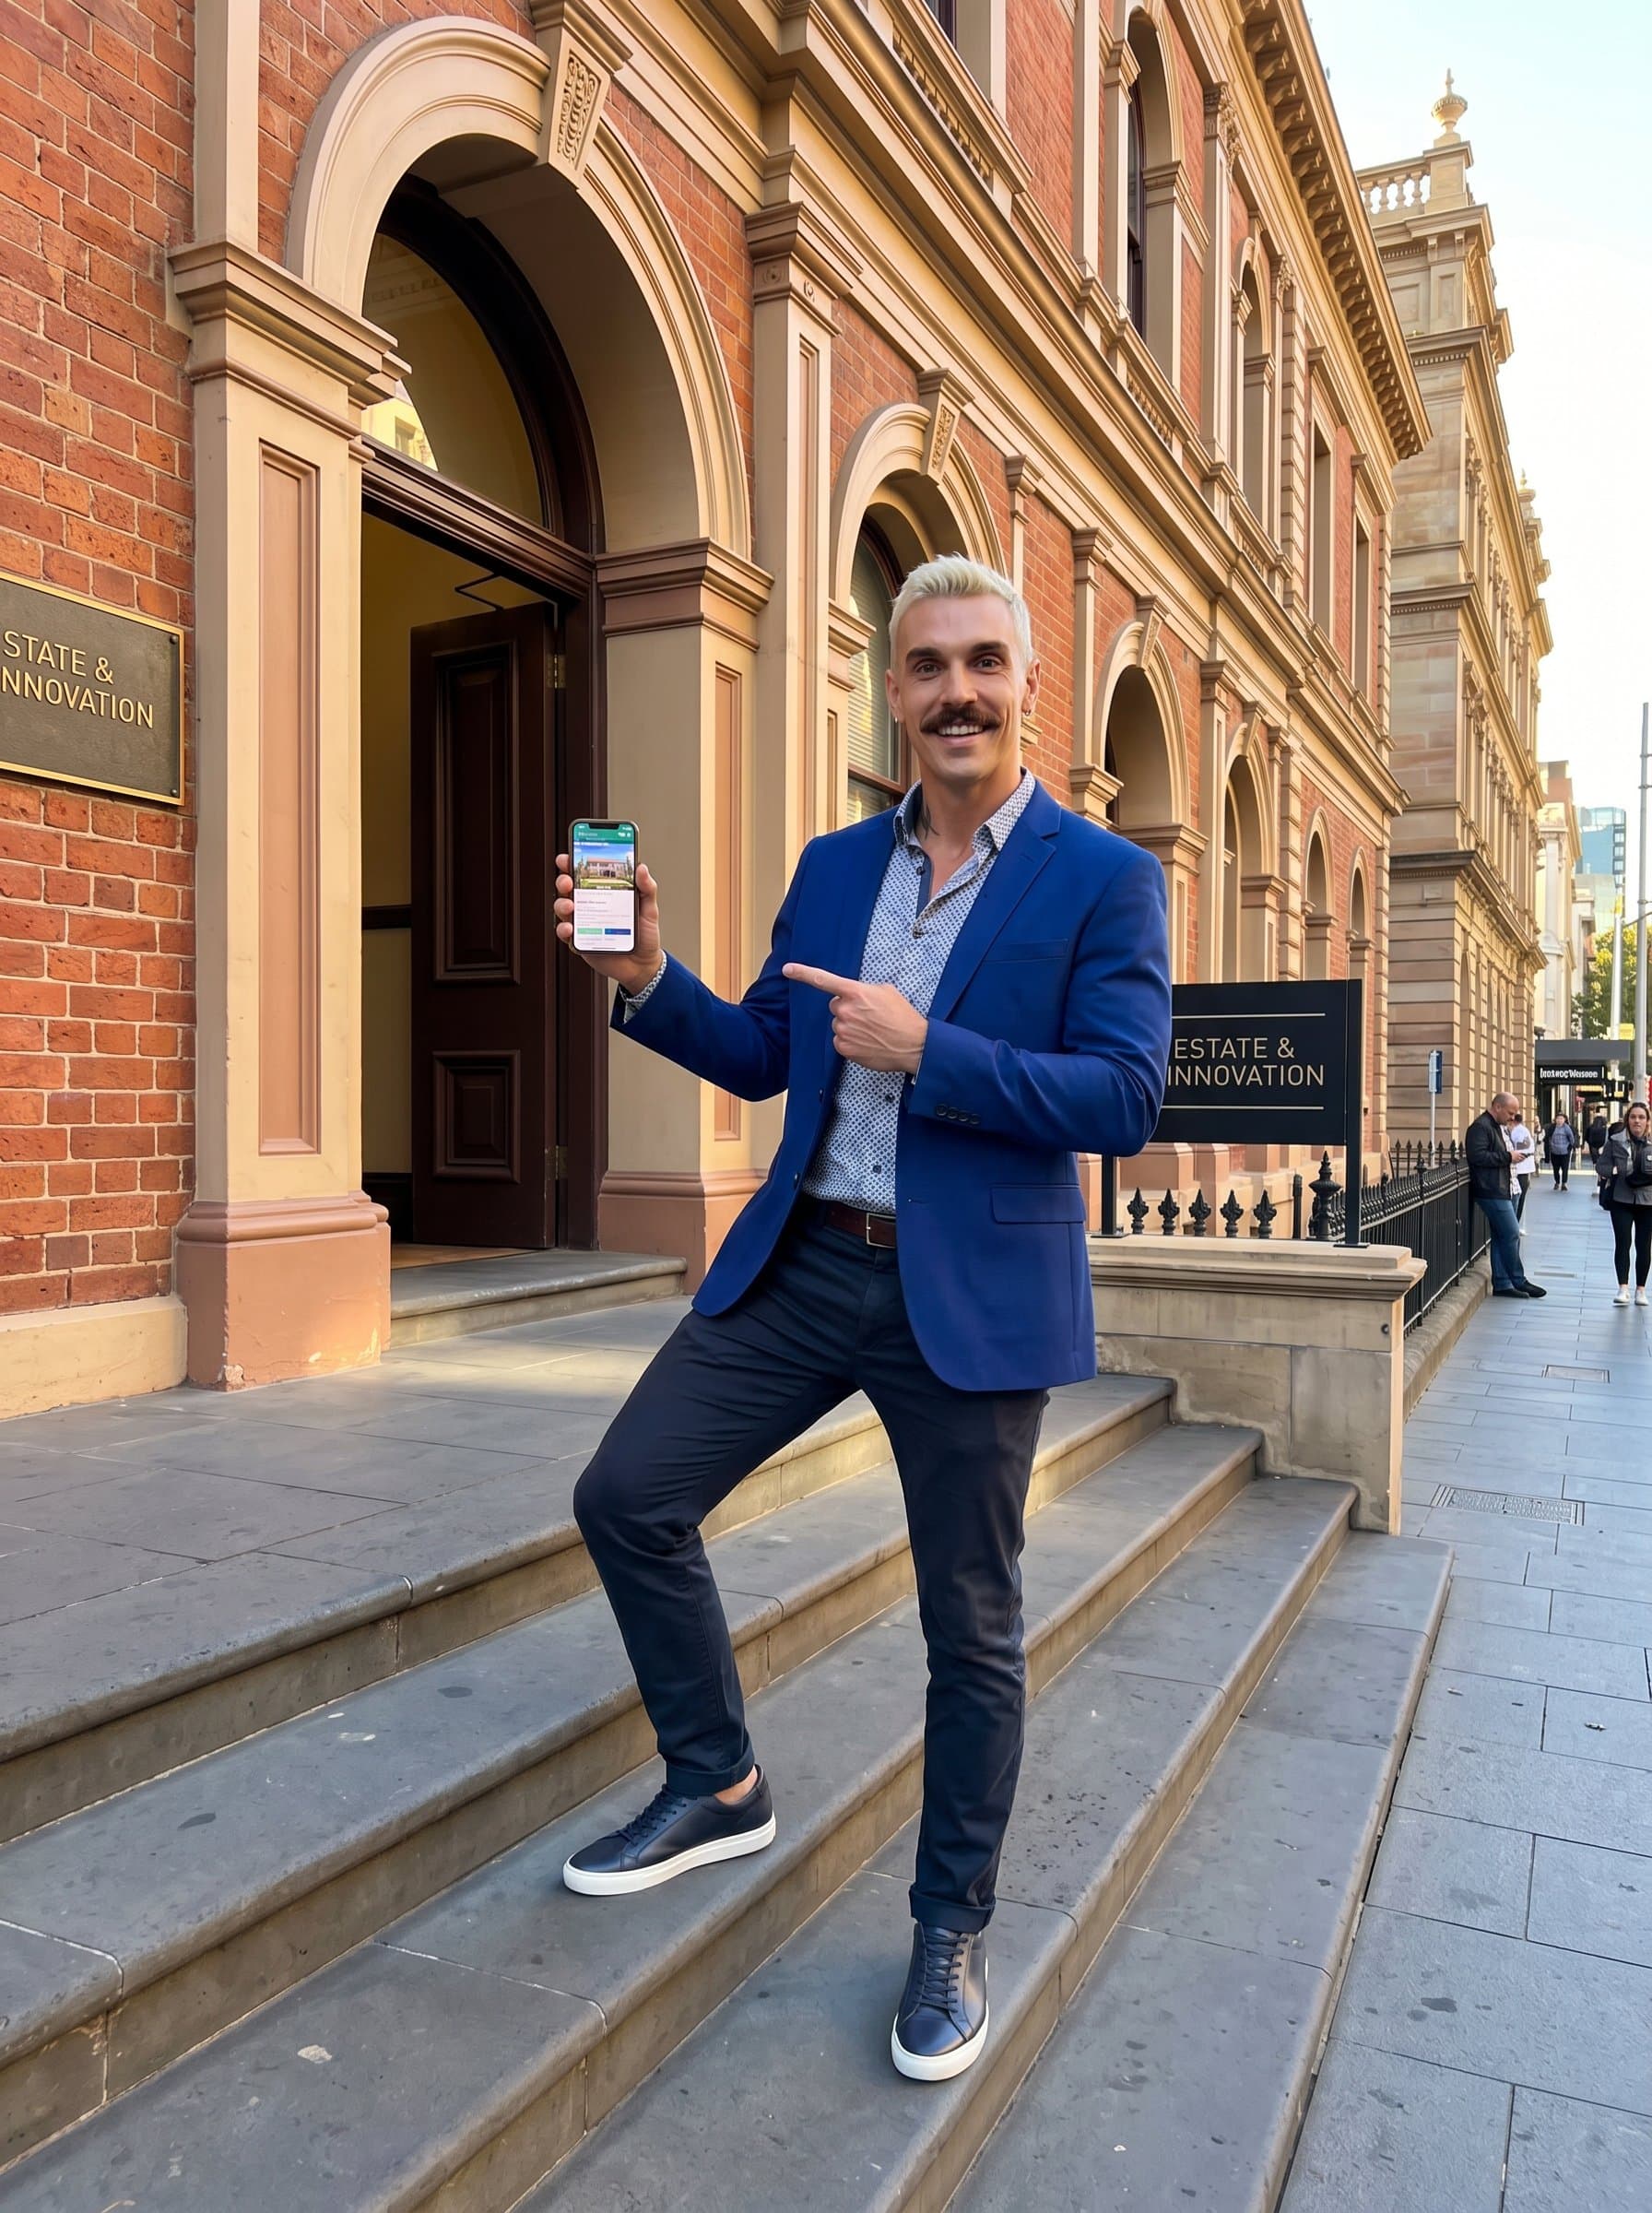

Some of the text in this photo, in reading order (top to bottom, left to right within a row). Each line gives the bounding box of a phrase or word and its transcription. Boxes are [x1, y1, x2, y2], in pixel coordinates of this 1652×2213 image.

[4, 631, 114, 684] STATE &
[2, 666, 153, 728] NNOVATION
[1174, 1036, 1295, 1059] ESTATE &
[1167, 1064, 1325, 1086] INNOVATION
